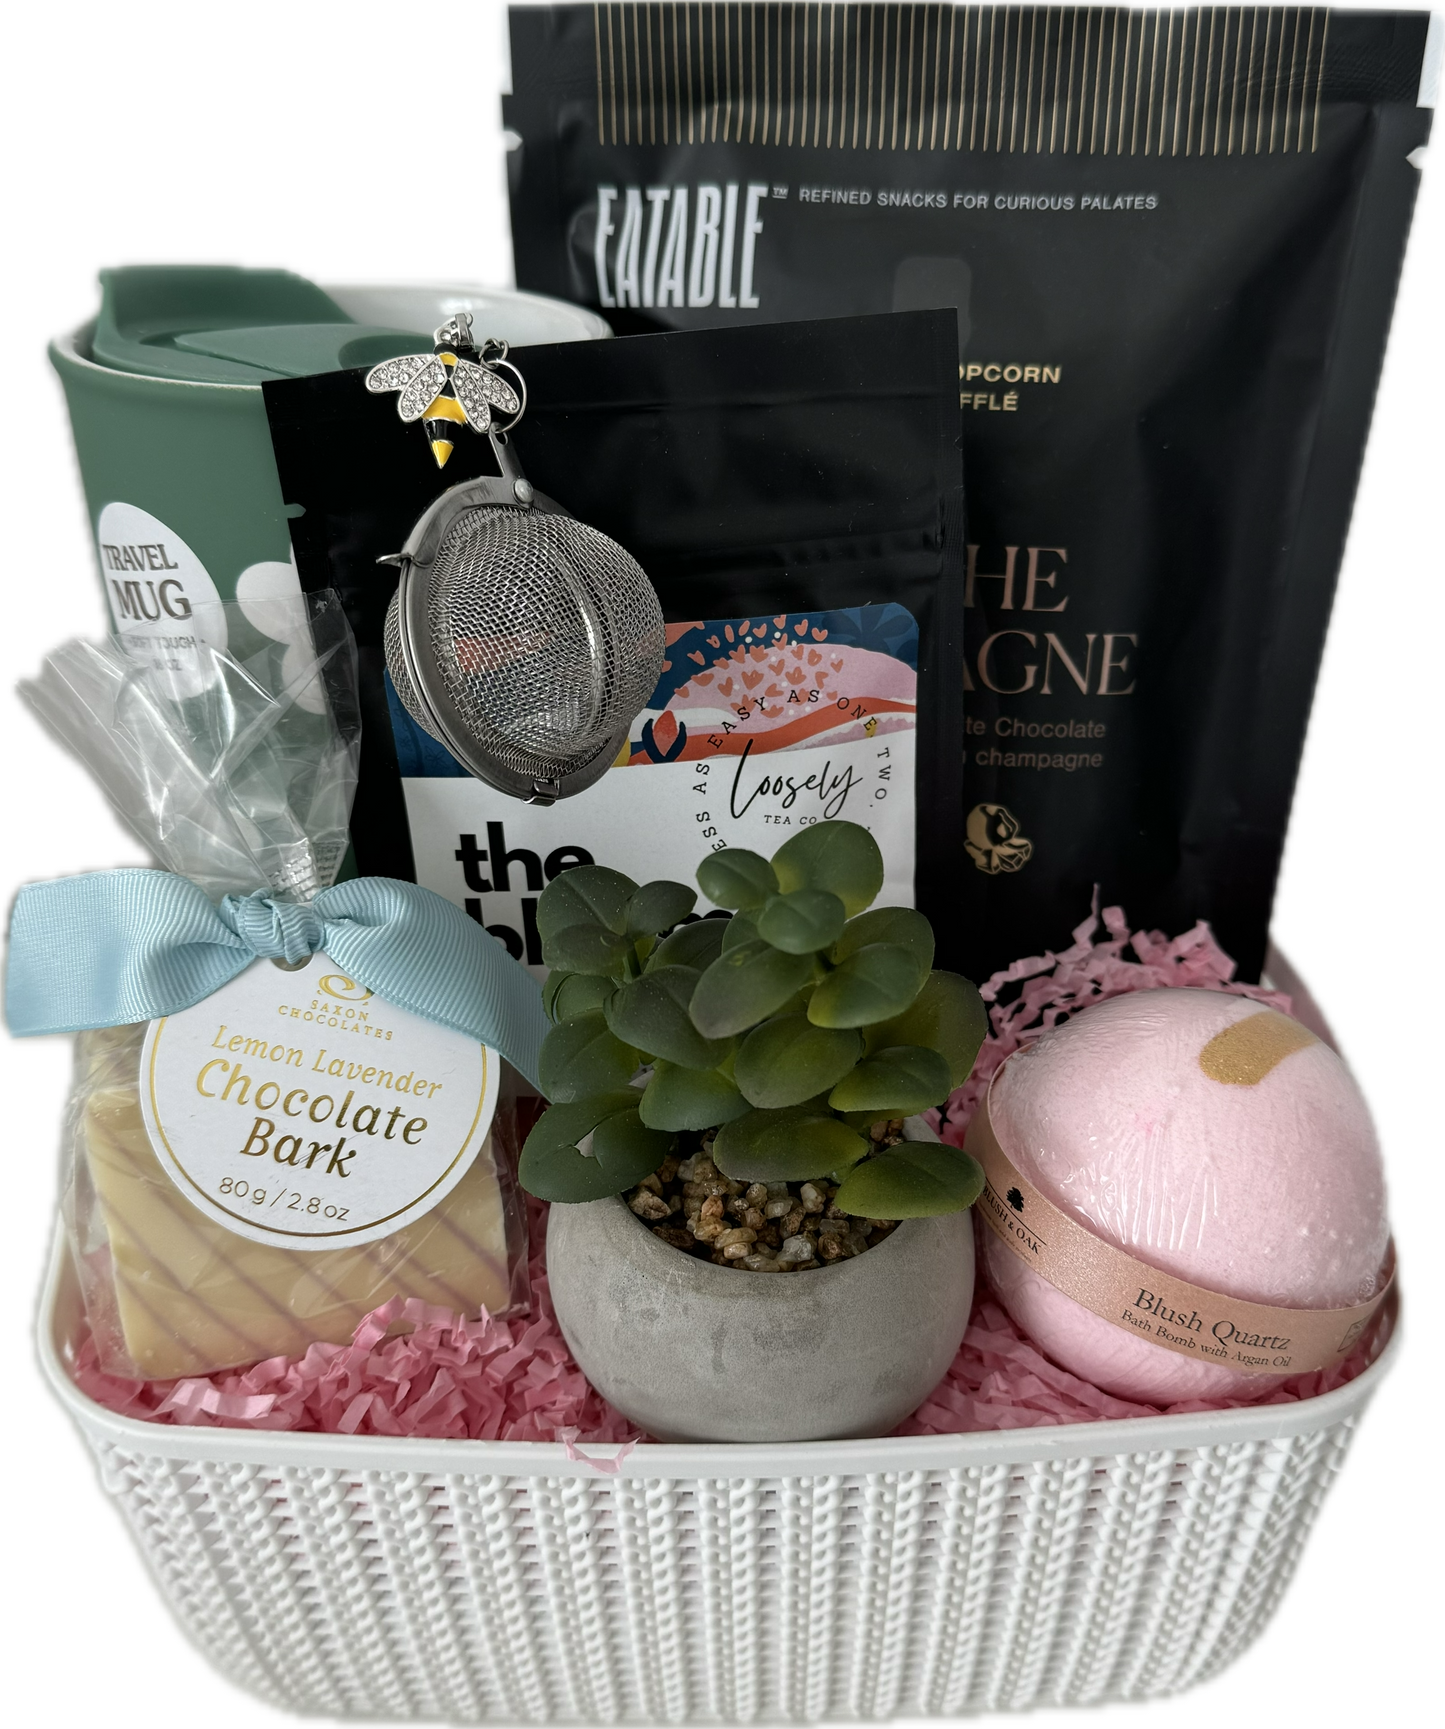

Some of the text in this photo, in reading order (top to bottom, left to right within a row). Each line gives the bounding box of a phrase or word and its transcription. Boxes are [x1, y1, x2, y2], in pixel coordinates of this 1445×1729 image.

[799, 188, 1158, 211] REFINED SNACKS FOR CURIOUS PALATES
[595, 184, 768, 309] EATABLE
[960, 391, 1019, 411] FFLÉ
[102, 543, 179, 571] TRAVEL
[964, 545, 1068, 612] HE
[112, 579, 193, 621] MUG
[692, 763, 710, 795] AS
[707, 696, 766, 749] EASY
[786, 689, 819, 703] AS
[995, 717, 1106, 738] Chocolate
[975, 748, 1104, 772] champagne
[764, 814, 791, 825] TEA
[455, 821, 595, 893] the
[278, 1005, 394, 1041] CHOCOLATES
[311, 1000, 369, 1022] SAXON
[212, 1025, 443, 1099] Lemon Lavender
[196, 1058, 428, 1145] Chocolate
[239, 1117, 357, 1178] Bark
[1016, 1227, 1042, 1255] OAK
[1121, 1309, 1292, 1368] Bath Bomb with Argan Oil
[1132, 1287, 1291, 1350] Blush Quartz
